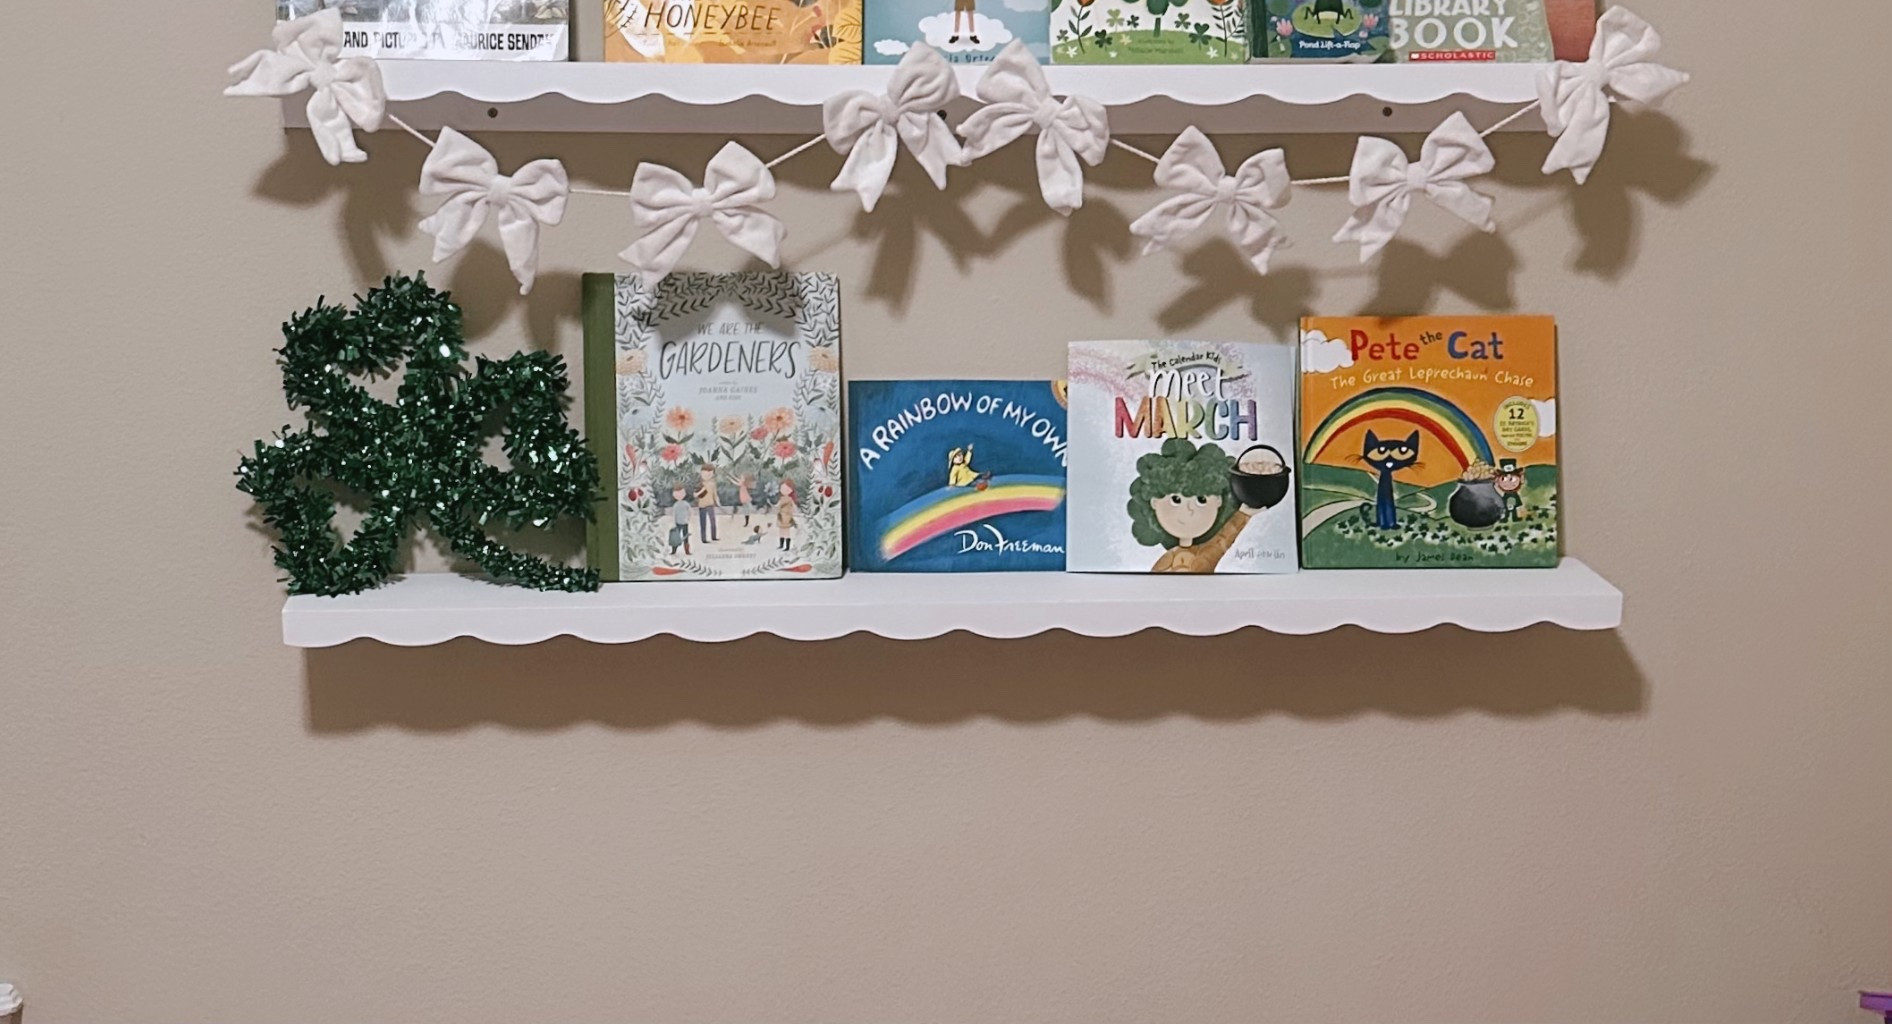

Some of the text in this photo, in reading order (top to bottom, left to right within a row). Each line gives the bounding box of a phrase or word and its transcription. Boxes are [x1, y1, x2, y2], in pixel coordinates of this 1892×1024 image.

[644, 0, 781, 30] HONEYBEE
[344, 31, 368, 48] AND
[1389, 16, 1518, 50] BOOK
[1420, 52, 1494, 60] SCHOLASTIC
[697, 321, 765, 335] WE ARE THE
[1350, 329, 1504, 361] Pete the Cat
[659, 340, 801, 380] GARDENERS
[1151, 351, 1222, 369] The Calendar Kids
[1330, 367, 1534, 390] The Great Leprechaun Chase
[1114, 395, 1258, 441] MARCH
[1509, 408, 1525, 420] 12
[859, 447, 881, 470] A
[872, 392, 973, 452] RAINBOW
[976, 395, 1003, 415] OF
[1003, 401, 1036, 427] MY
[954, 529, 993, 554] Don
